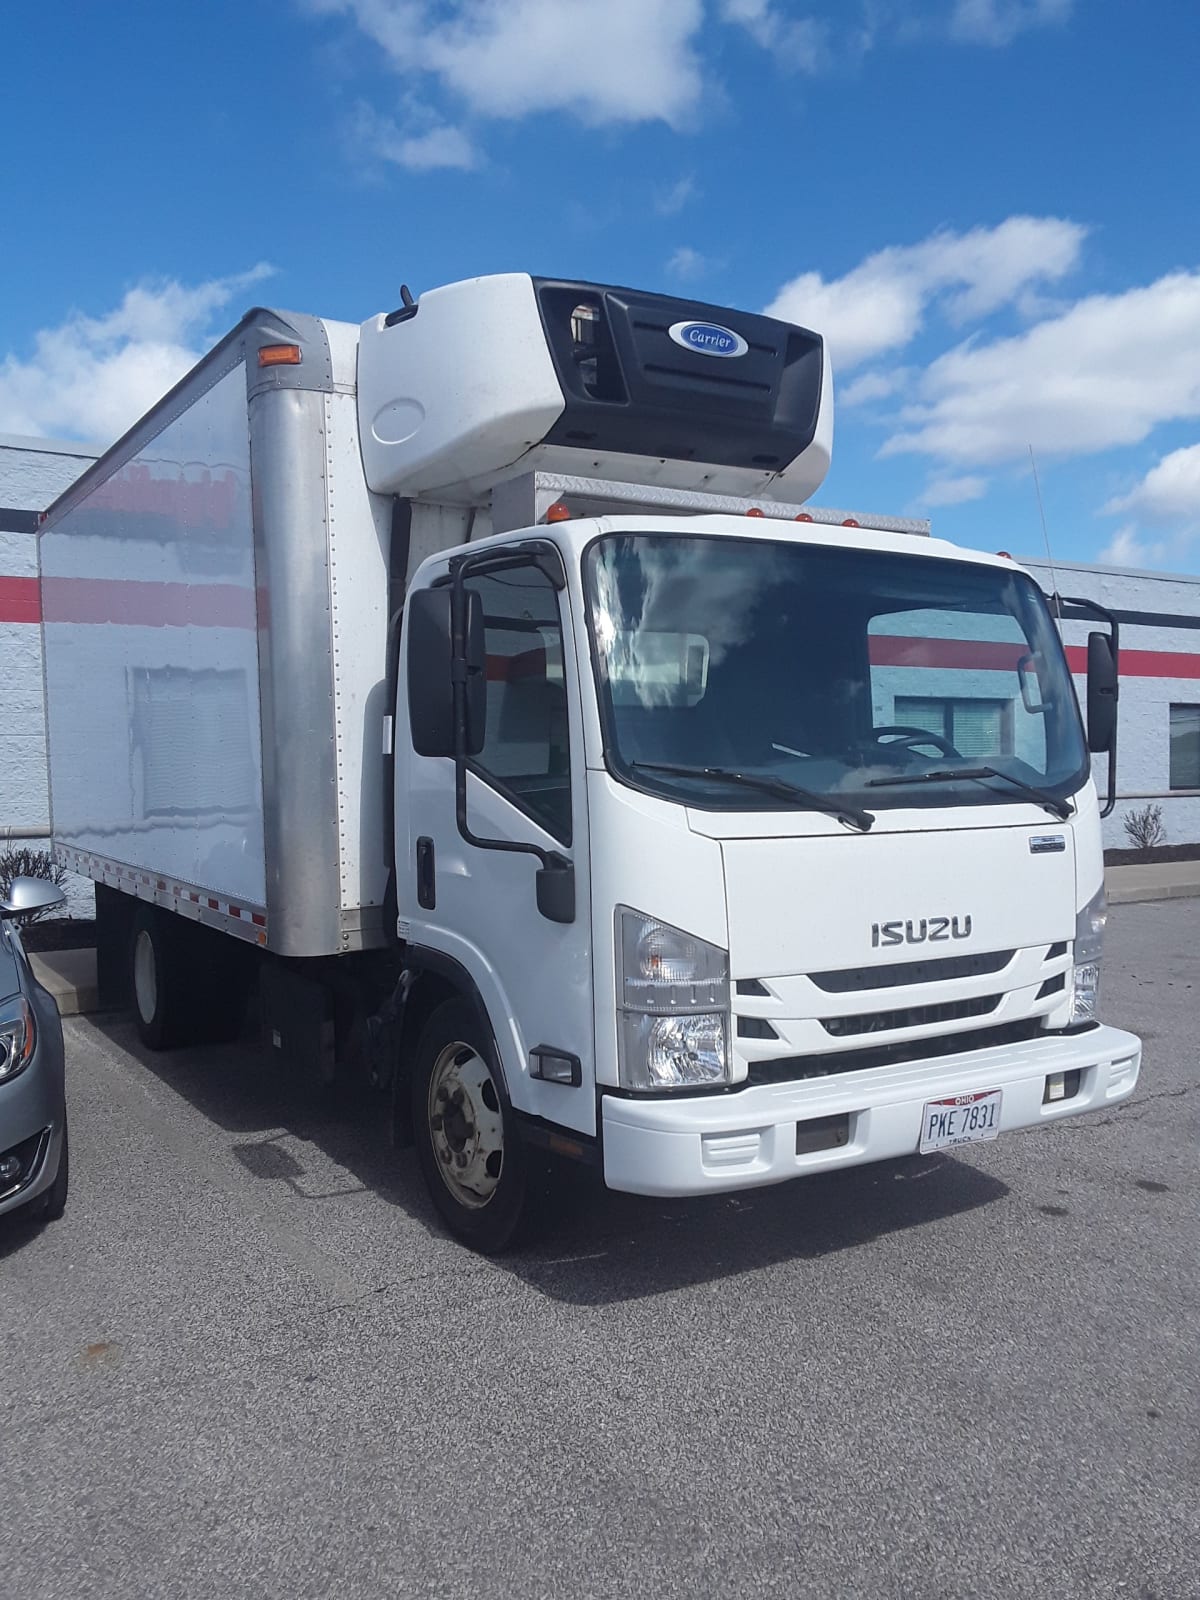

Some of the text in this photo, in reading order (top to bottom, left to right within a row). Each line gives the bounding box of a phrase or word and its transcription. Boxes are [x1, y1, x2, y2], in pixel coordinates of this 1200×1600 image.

[689, 329, 731, 348] Carrier
[871, 914, 972, 948] ISUZU
[954, 1095, 975, 1105] OHIO
[928, 1102, 995, 1140] PKE 7831
